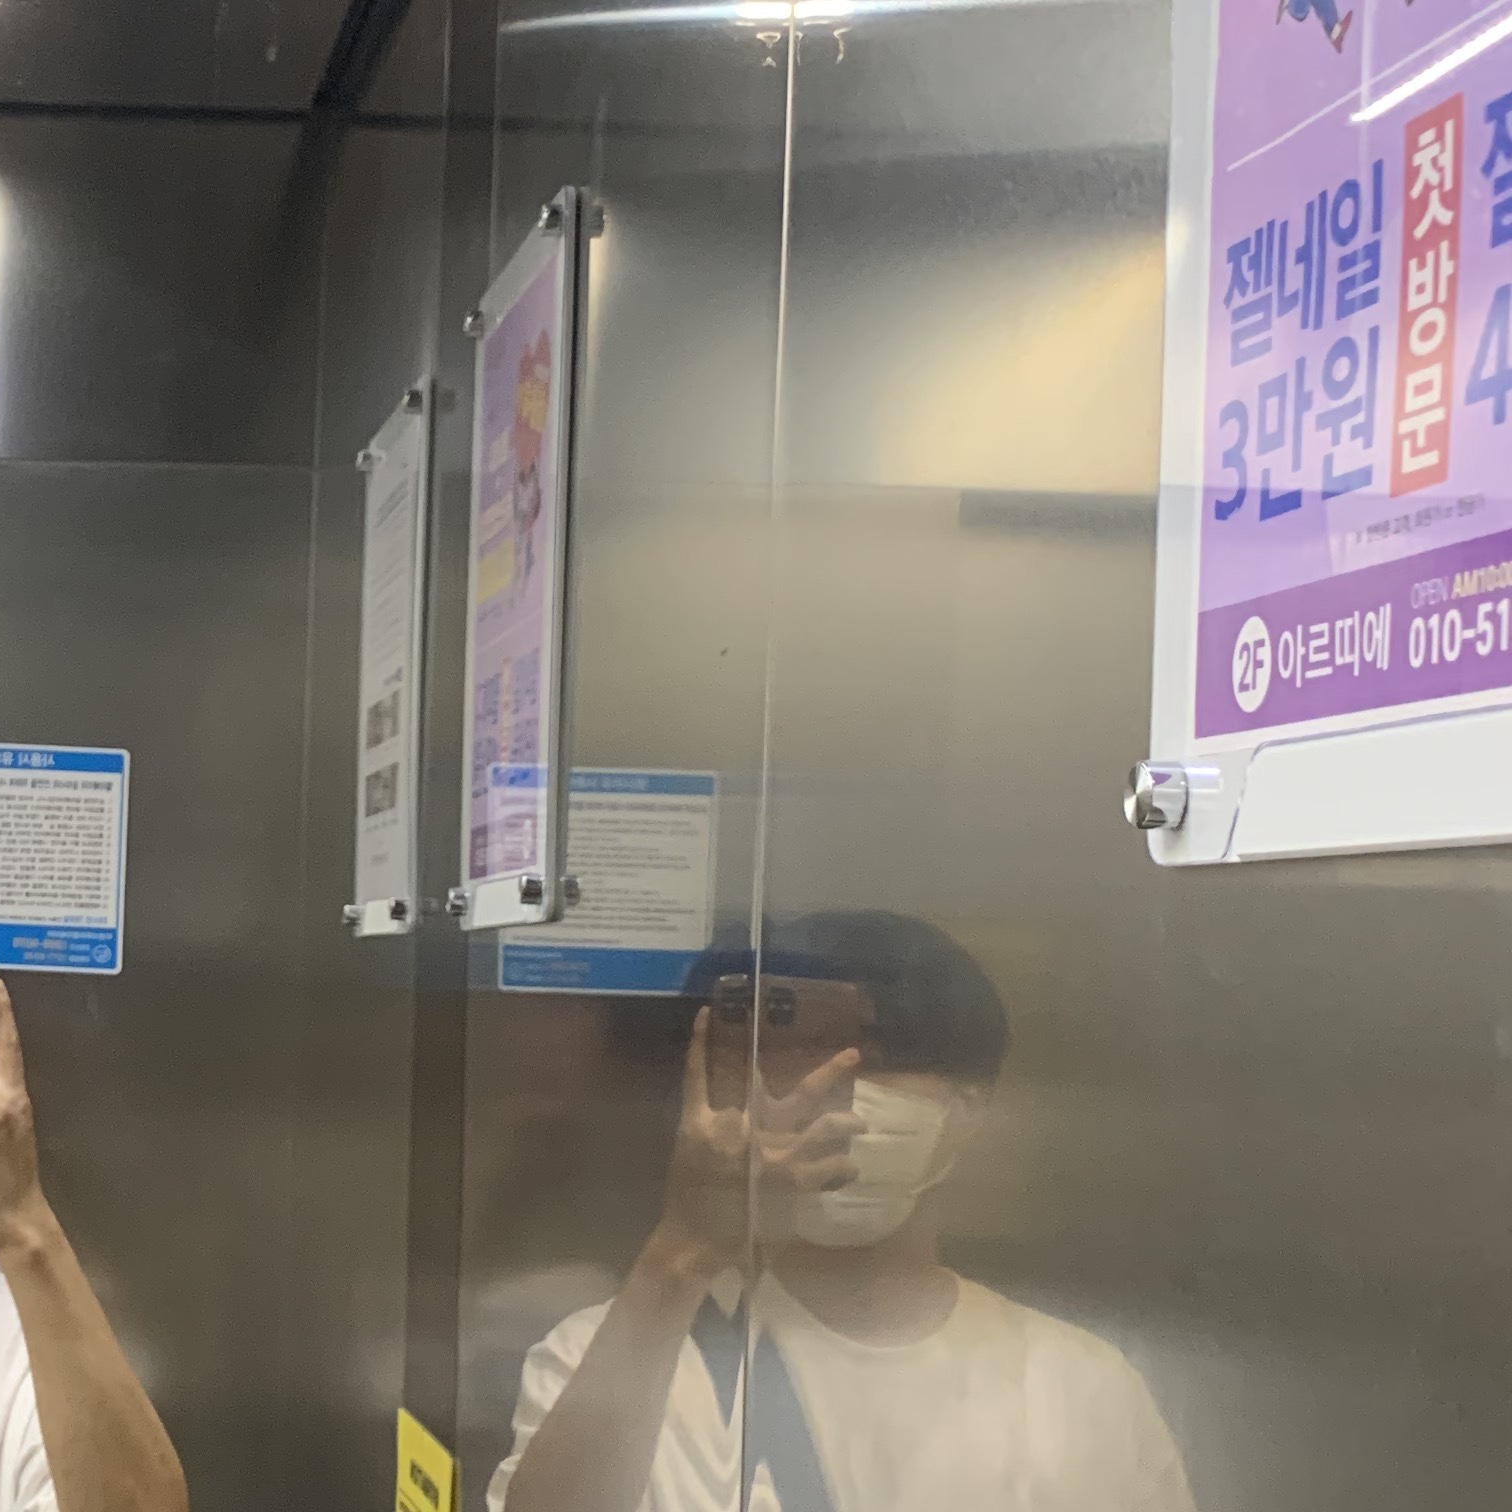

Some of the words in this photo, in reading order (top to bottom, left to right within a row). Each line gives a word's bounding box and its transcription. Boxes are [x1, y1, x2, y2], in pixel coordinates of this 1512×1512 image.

[1223, 158, 1383, 368] 젤네일
[1398, 118, 1455, 475] 첫방문
[1215, 324, 1380, 522] 3만원
[1278, 602, 1392, 688] 아르띠에
[1410, 576, 1449, 608] OPEN
[1238, 638, 1266, 693] 2F
